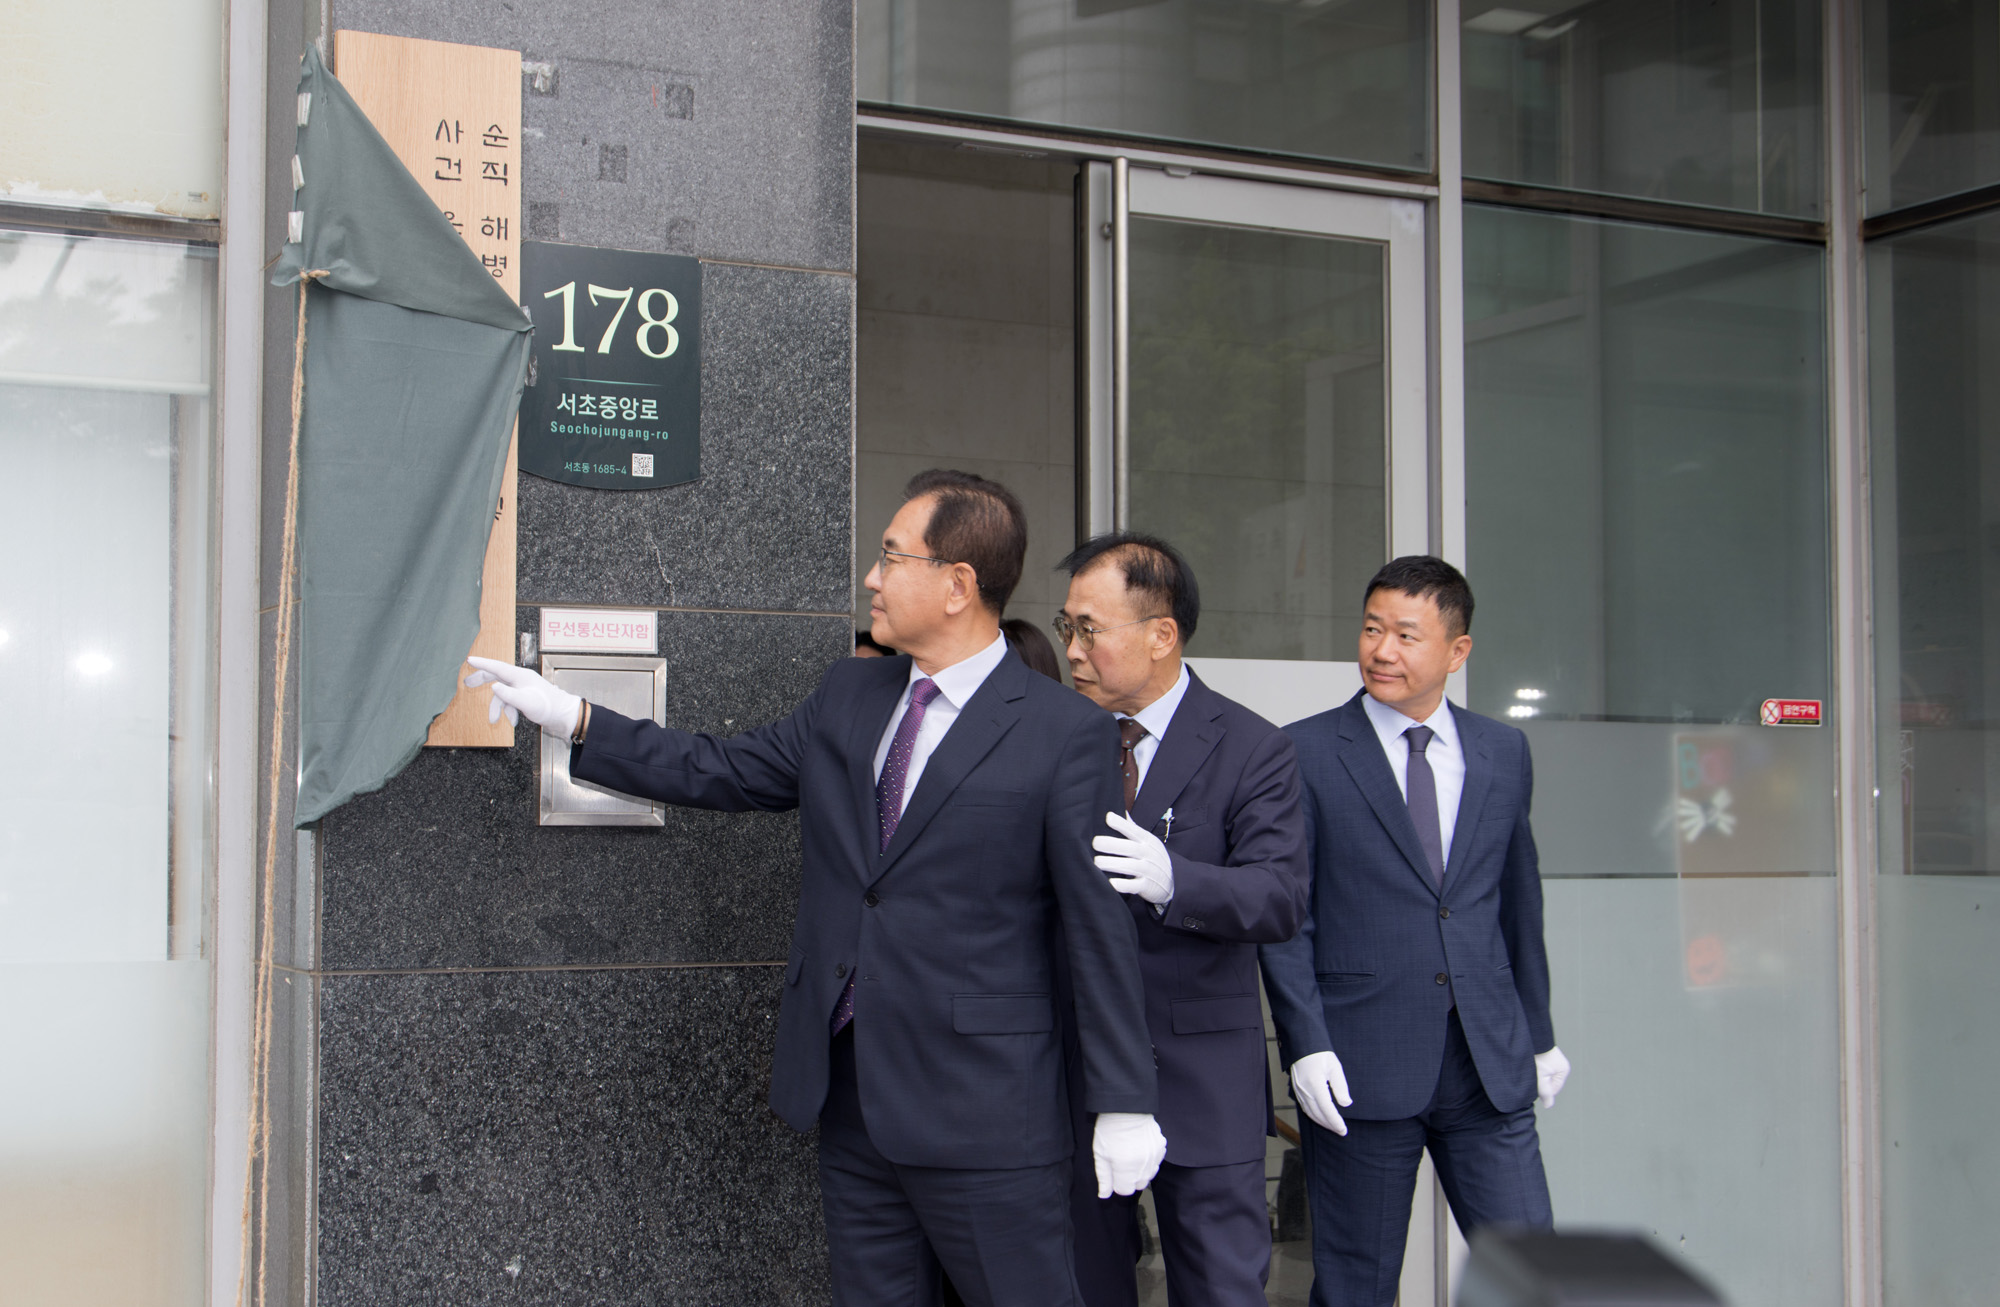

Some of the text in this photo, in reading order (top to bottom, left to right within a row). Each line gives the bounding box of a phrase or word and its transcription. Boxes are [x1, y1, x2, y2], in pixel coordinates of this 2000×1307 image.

[435, 119, 464, 181] 사건
[481, 124, 509, 277] 순직 해병
[543, 280, 680, 359] 178
[556, 393, 659, 420] 서초중앙로
[550, 420, 669, 441] Seochojungang-ro
[564, 461, 627, 475] 서초동 1685-4
[547, 621, 649, 640] 무선통신단자함
[1783, 704, 1816, 716] 금연구역
